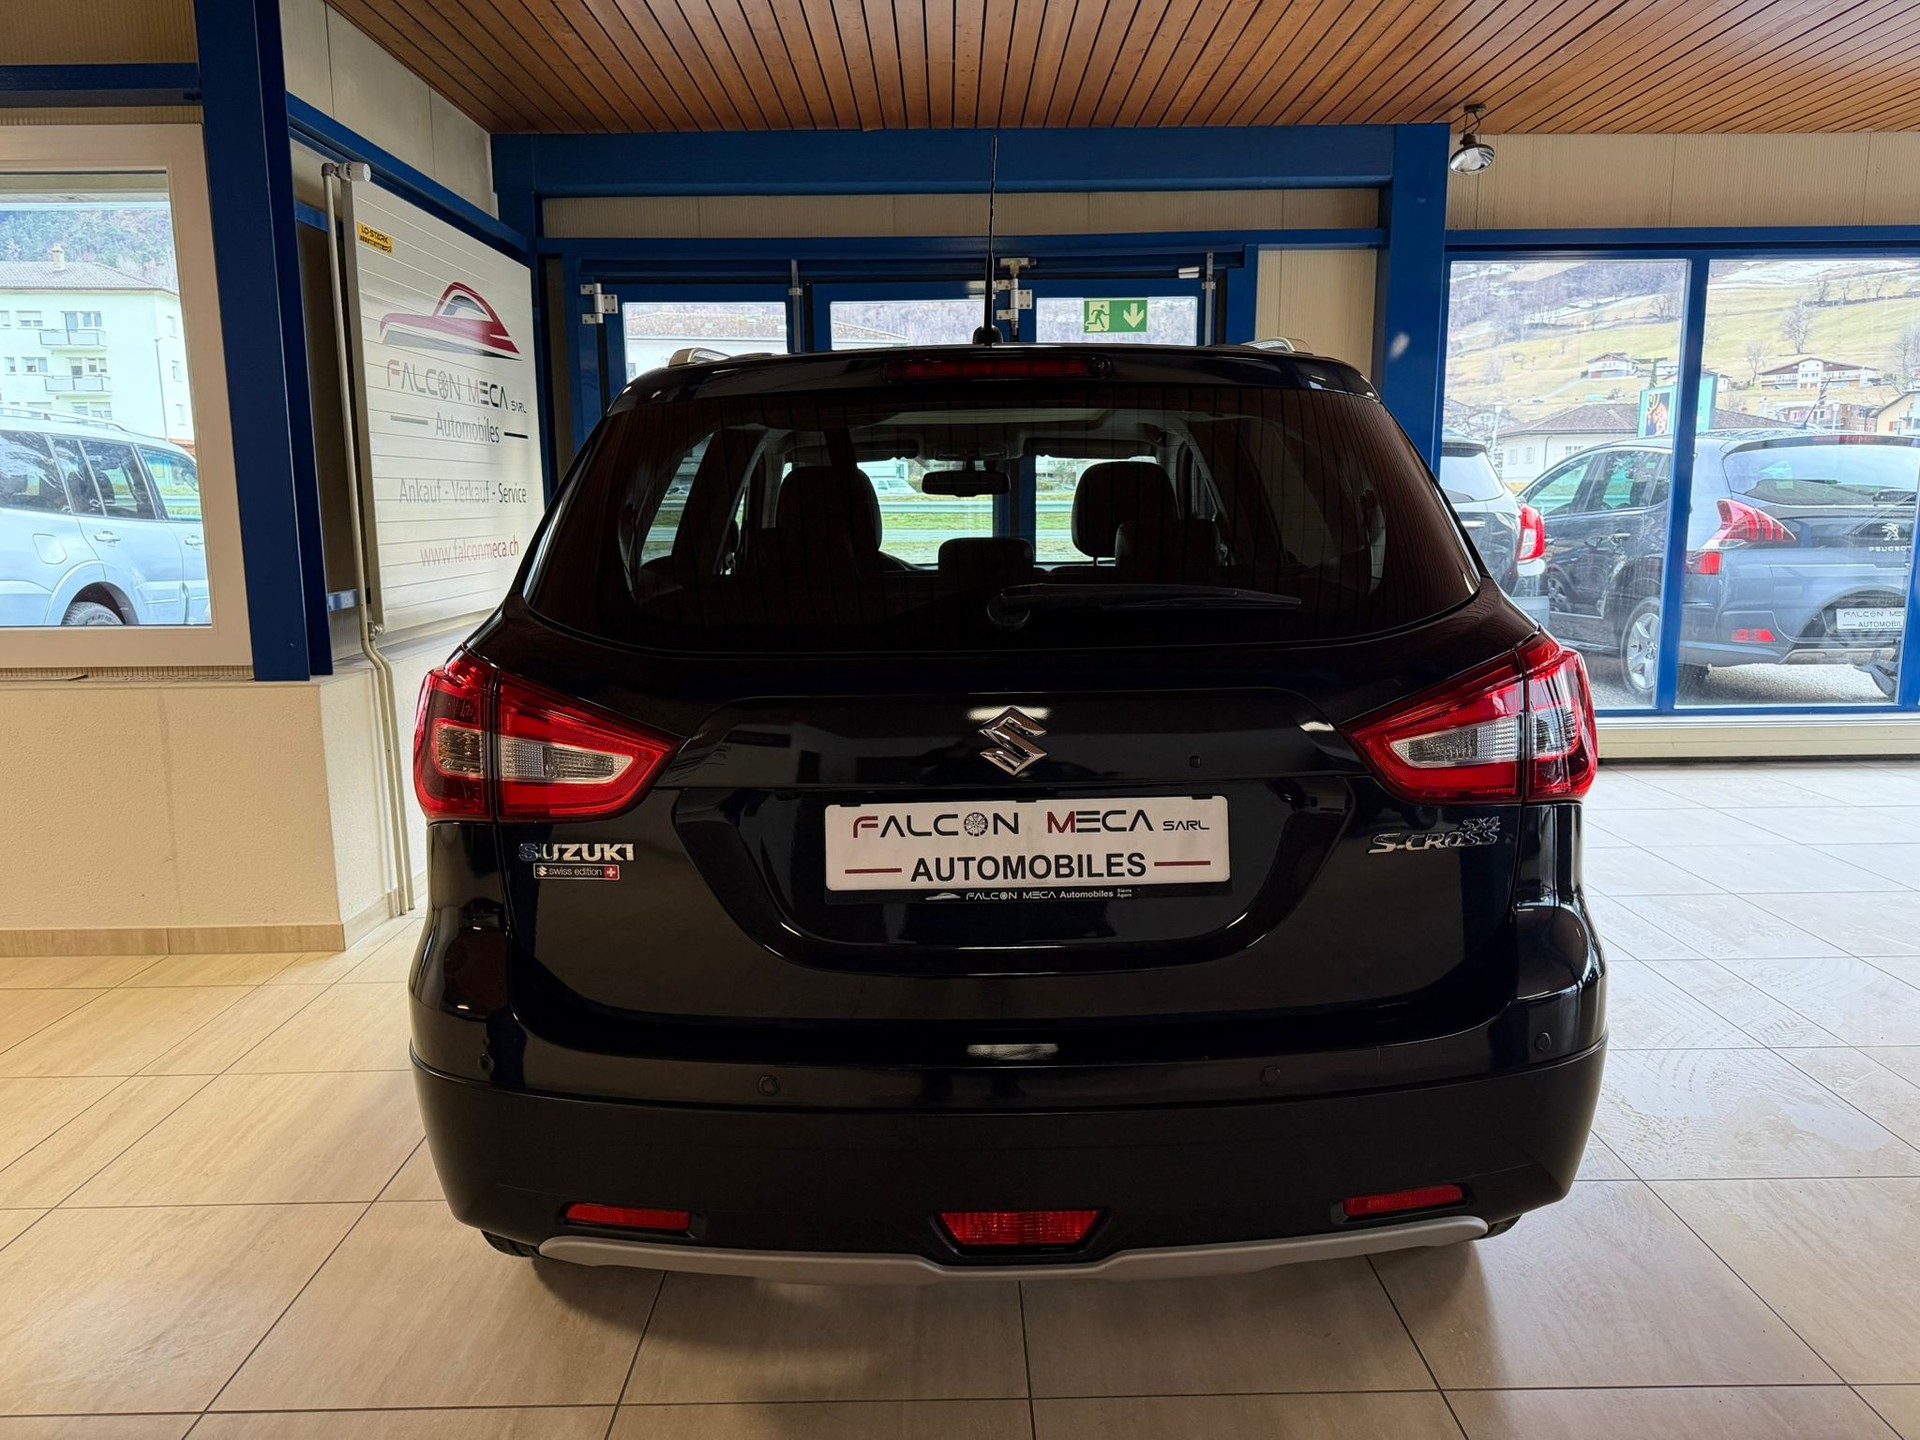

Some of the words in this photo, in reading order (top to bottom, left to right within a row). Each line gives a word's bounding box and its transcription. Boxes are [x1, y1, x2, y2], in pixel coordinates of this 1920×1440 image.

[387, 359, 461, 400] FALCON
[467, 376, 508, 410] MECA
[435, 412, 500, 443] Automobiles
[399, 478, 441, 503] Ankauf
[451, 480, 489, 504] Verkauf
[498, 482, 527, 503] Service
[420, 535, 520, 566] www.falconmeca.ch
[853, 812, 1019, 838] FALCON
[1047, 810, 1154, 834] MECA
[1162, 820, 1210, 831] SARL
[1460, 816, 1501, 832] SX4
[519, 843, 635, 862] SUZUKI
[549, 867, 573, 876] swiss
[574, 866, 602, 876] edition
[910, 852, 1147, 883] AUTOMOBILES
[965, 892, 1018, 901] FALCON
[1022, 890, 1057, 900] MECA
[1059, 889, 1114, 899] Automobiles
